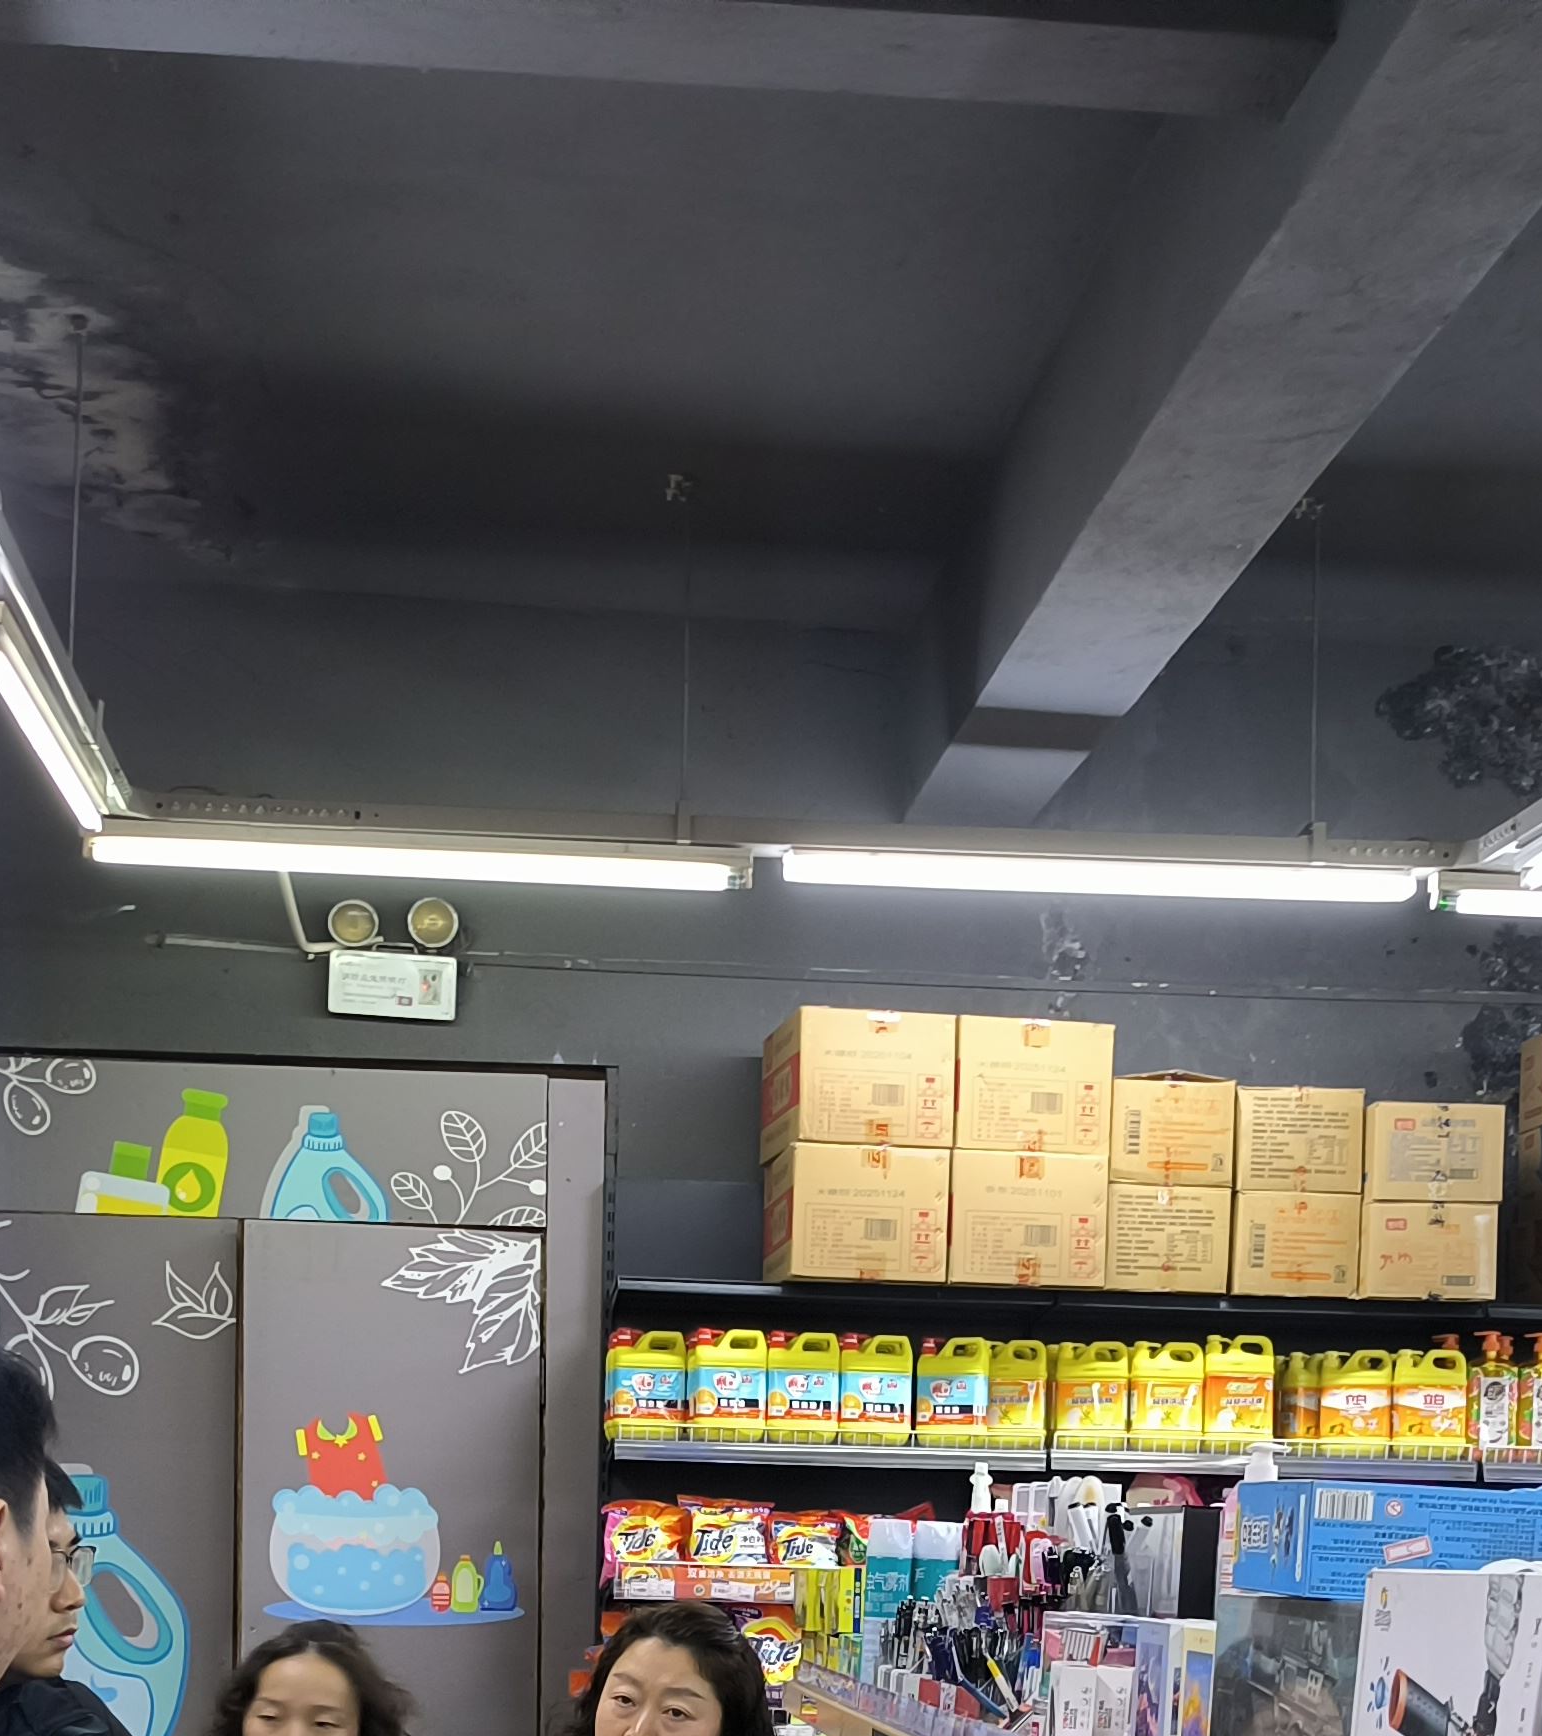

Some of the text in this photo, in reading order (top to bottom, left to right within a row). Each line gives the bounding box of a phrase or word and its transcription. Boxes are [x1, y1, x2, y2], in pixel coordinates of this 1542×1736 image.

[618, 1527, 656, 1553] Tide
[695, 1528, 735, 1557] Tide
[782, 1536, 814, 1561] Tide
